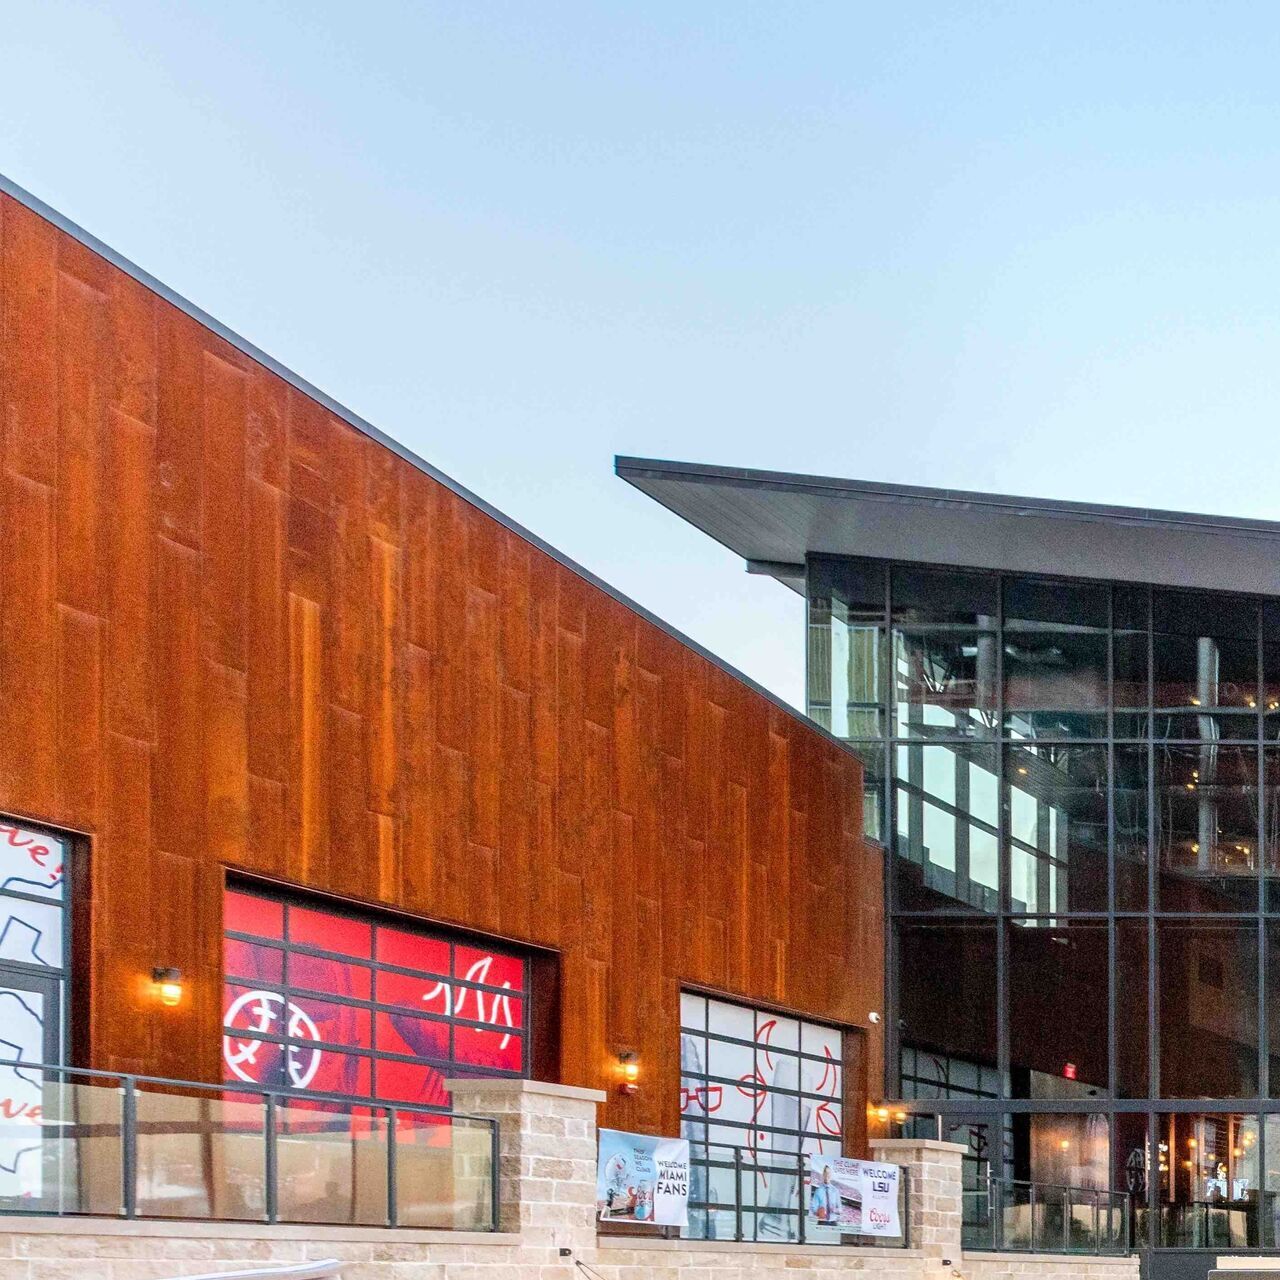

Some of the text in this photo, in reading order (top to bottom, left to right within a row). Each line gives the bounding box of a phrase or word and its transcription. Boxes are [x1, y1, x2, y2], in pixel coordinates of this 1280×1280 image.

[657, 1160, 687, 1170] WELCOME
[658, 1170, 687, 1181] MIAMI
[862, 1168, 896, 1180] WELCOME
[656, 1182, 687, 1196] FANS
[872, 1180, 890, 1193] LSU
